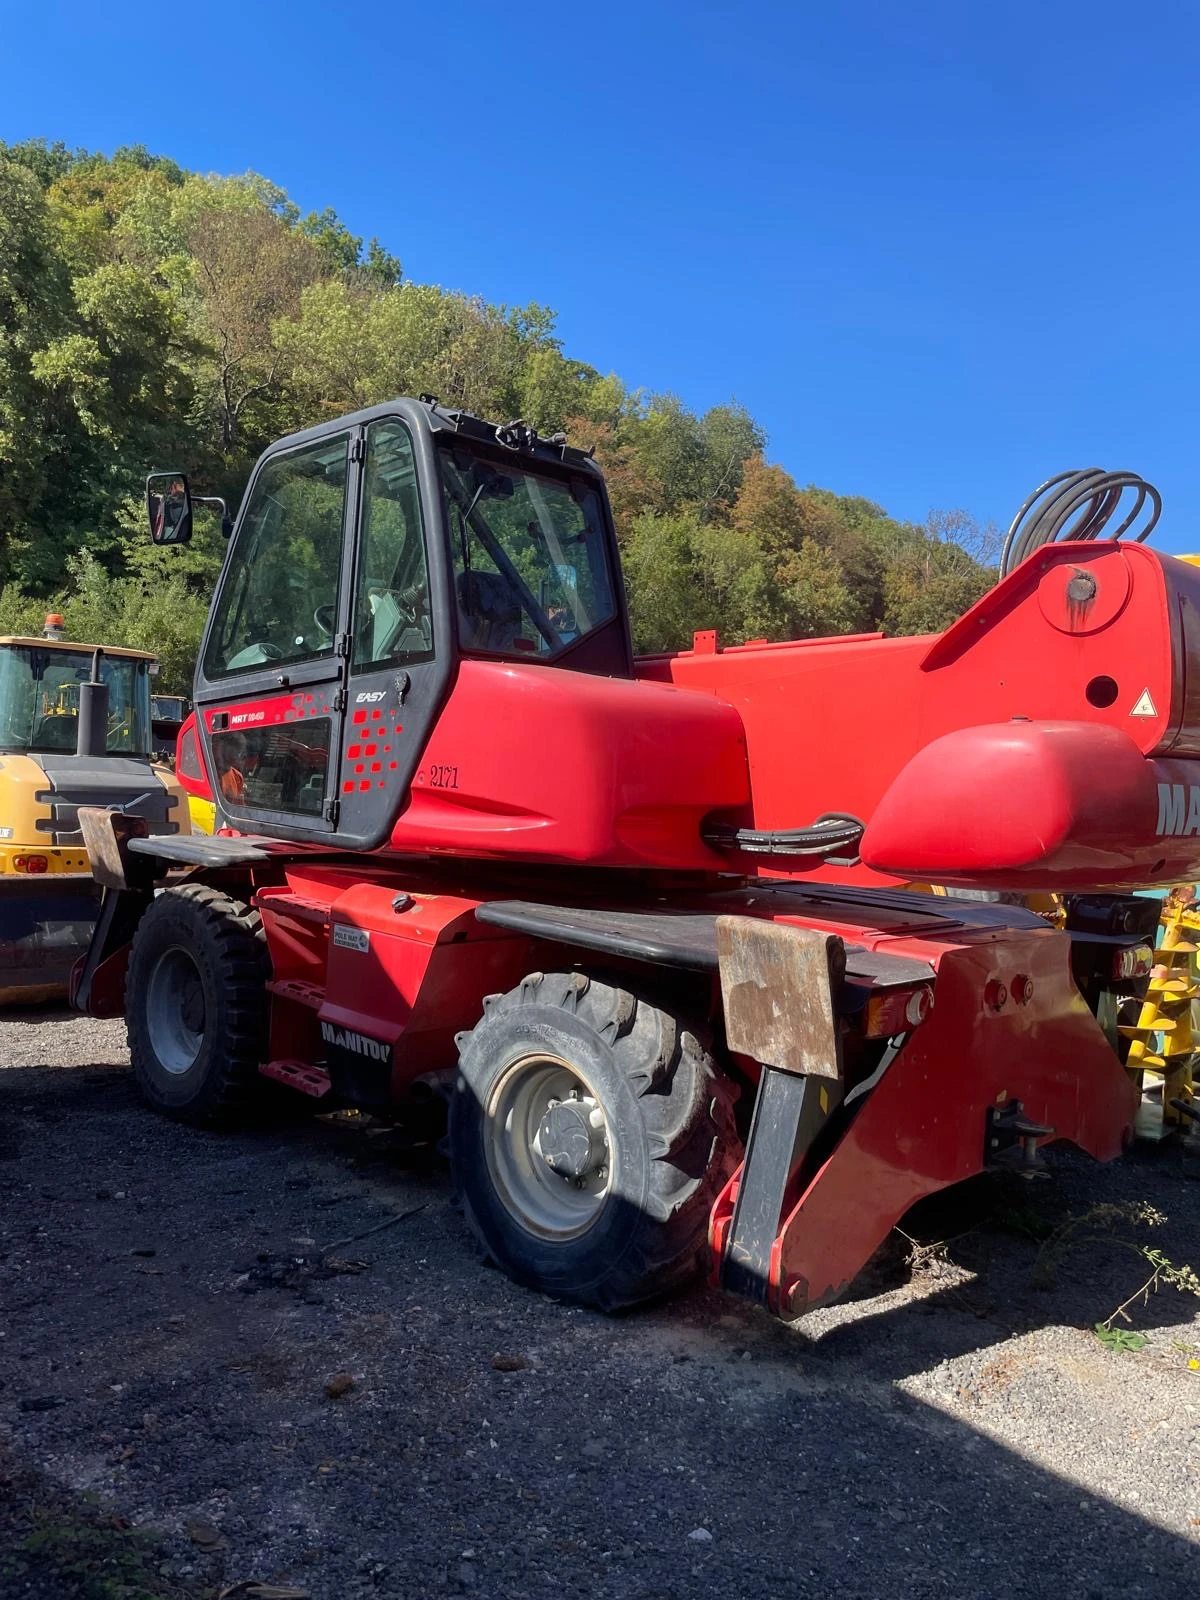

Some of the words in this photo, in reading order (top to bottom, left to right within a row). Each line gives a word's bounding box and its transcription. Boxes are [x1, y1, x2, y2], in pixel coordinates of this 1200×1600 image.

[355, 691, 387, 703] EASY
[231, 713, 248, 725] MRT
[430, 764, 459, 789] 2171
[320, 1021, 391, 1063] MANITOU
